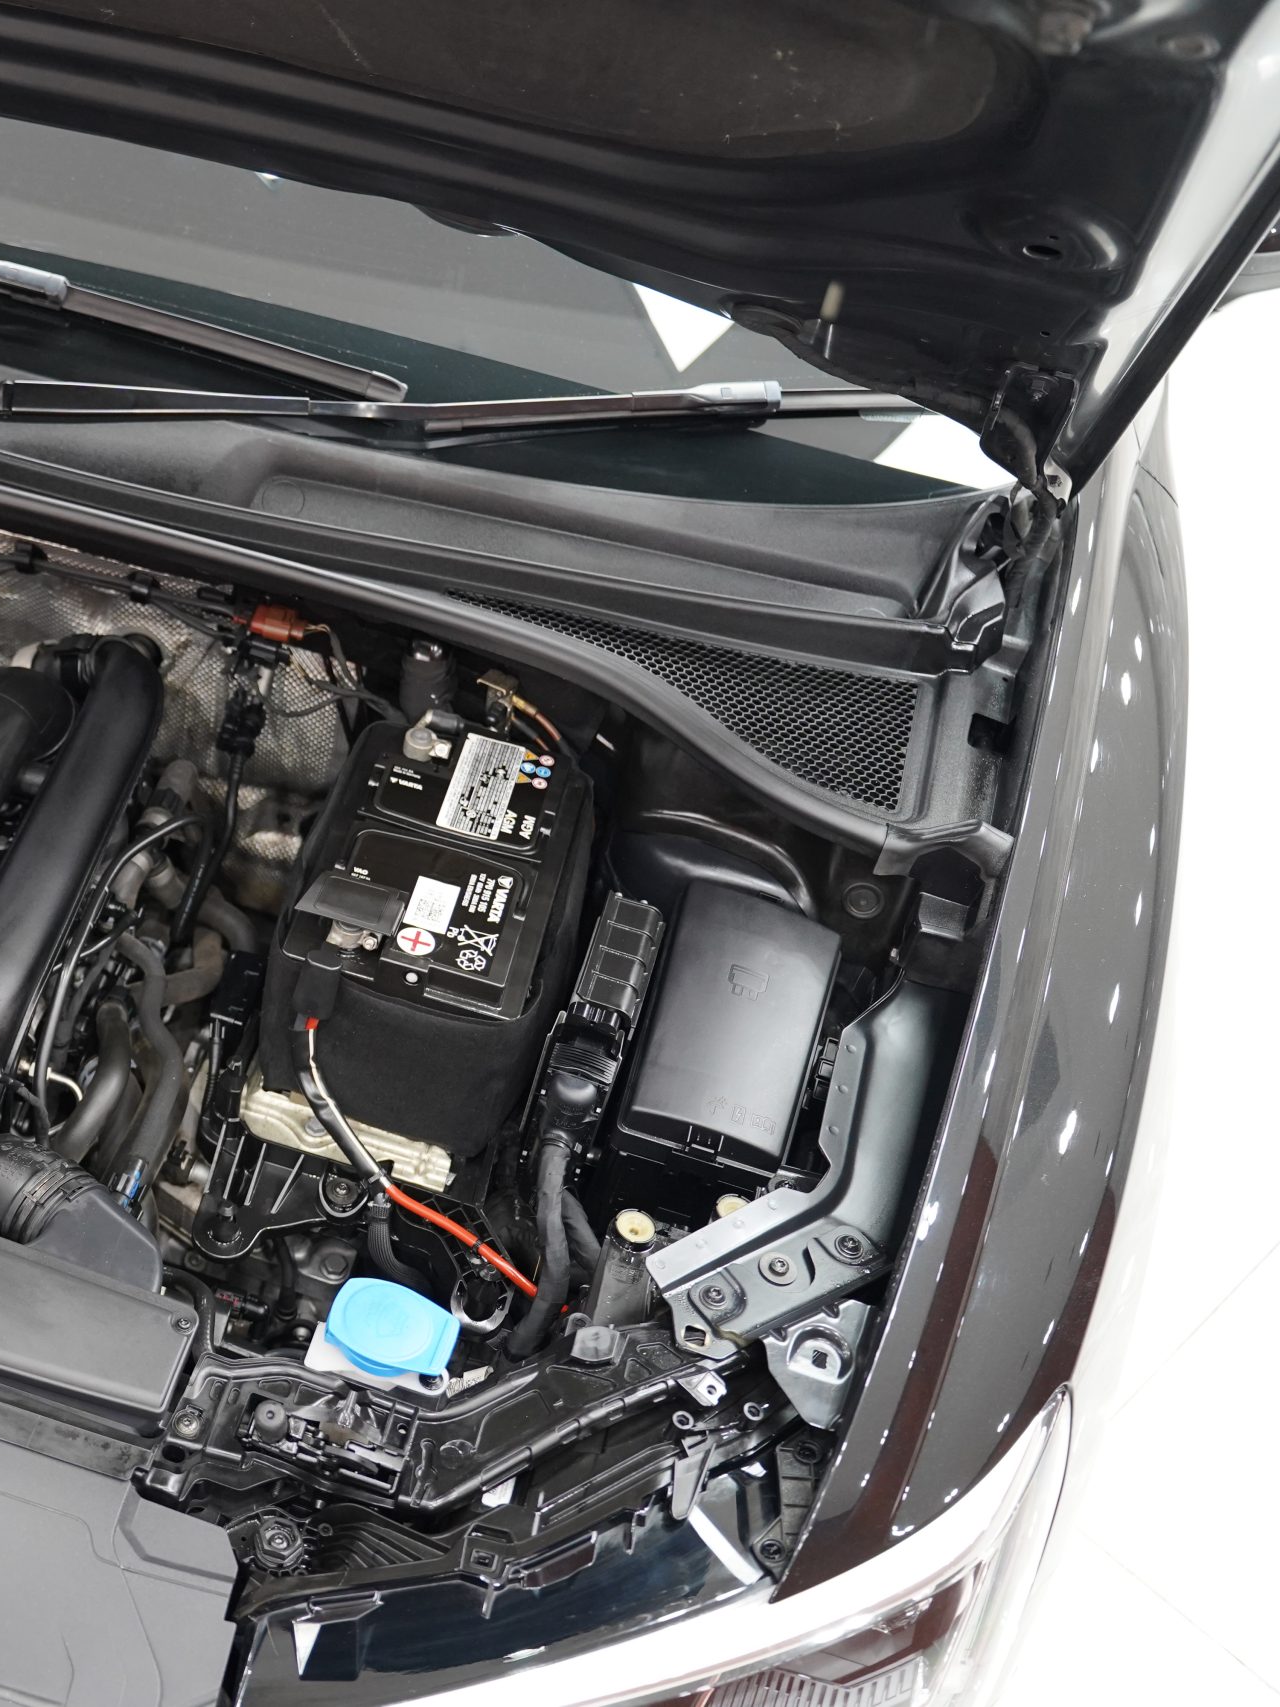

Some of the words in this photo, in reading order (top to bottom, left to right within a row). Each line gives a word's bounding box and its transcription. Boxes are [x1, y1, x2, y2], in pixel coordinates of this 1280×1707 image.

[398, 778, 423, 791] VARTA
[500, 809, 518, 835] AGM
[519, 814, 536, 840] AGM
[486, 888, 510, 924] VARTA
[446, 926, 460, 938] Pb
